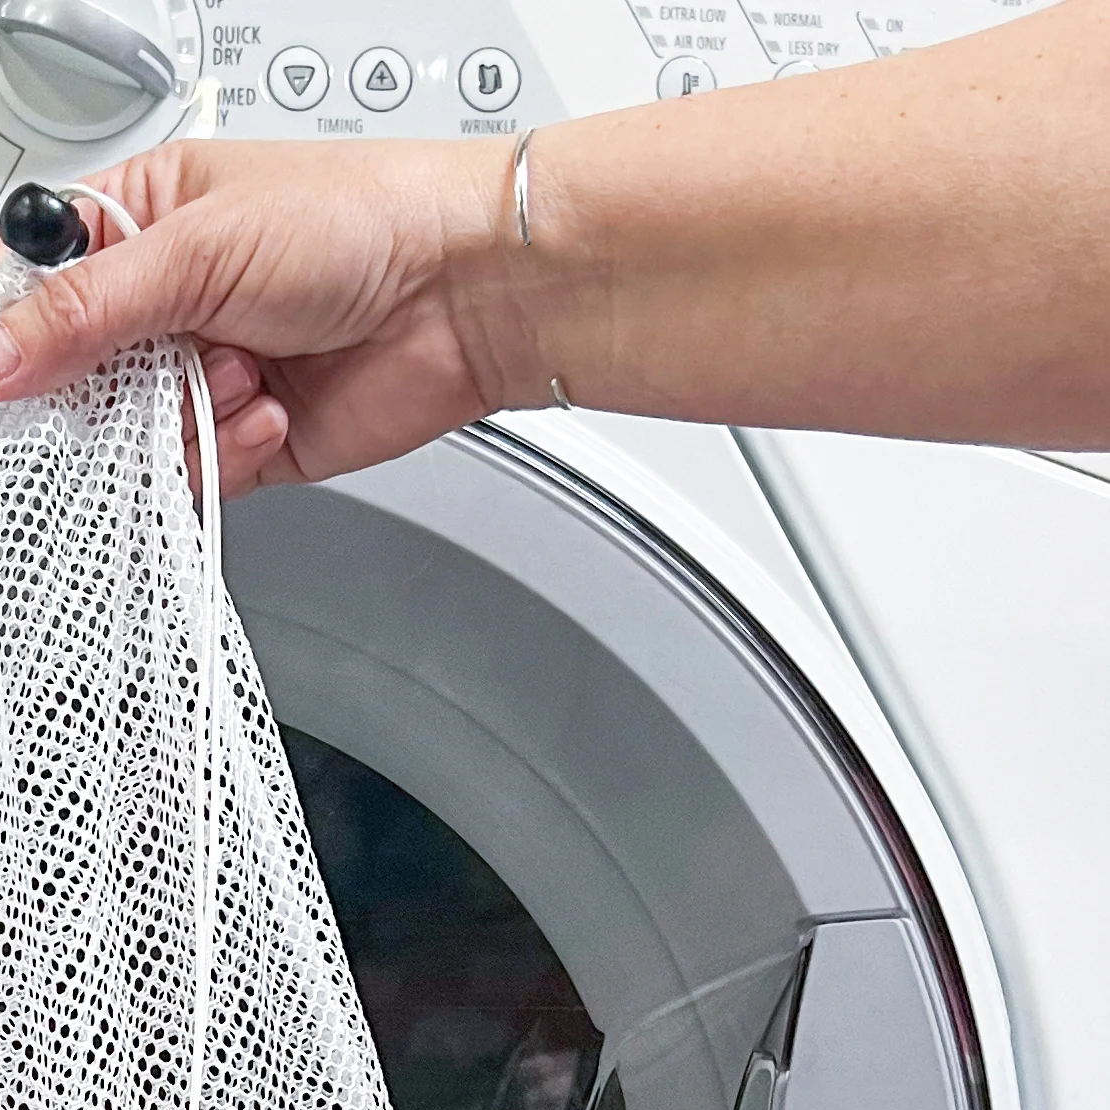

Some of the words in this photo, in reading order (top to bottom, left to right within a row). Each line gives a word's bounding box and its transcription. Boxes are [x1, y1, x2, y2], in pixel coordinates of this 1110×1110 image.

[660, 6, 696, 21] EXTRA
[699, 9, 727, 23] LOW
[773, 13, 823, 29] NORMAL
[886, 18, 904, 33] ON
[213, 25, 261, 47] QUICK
[673, 35, 693, 49] AIR
[696, 36, 728, 51] ONLY
[213, 47, 243, 66] DRY
[788, 40, 814, 56] LESS
[817, 42, 840, 57] DRY
[216, 87, 256, 106] IMED
[317, 118, 363, 134] TIMING
